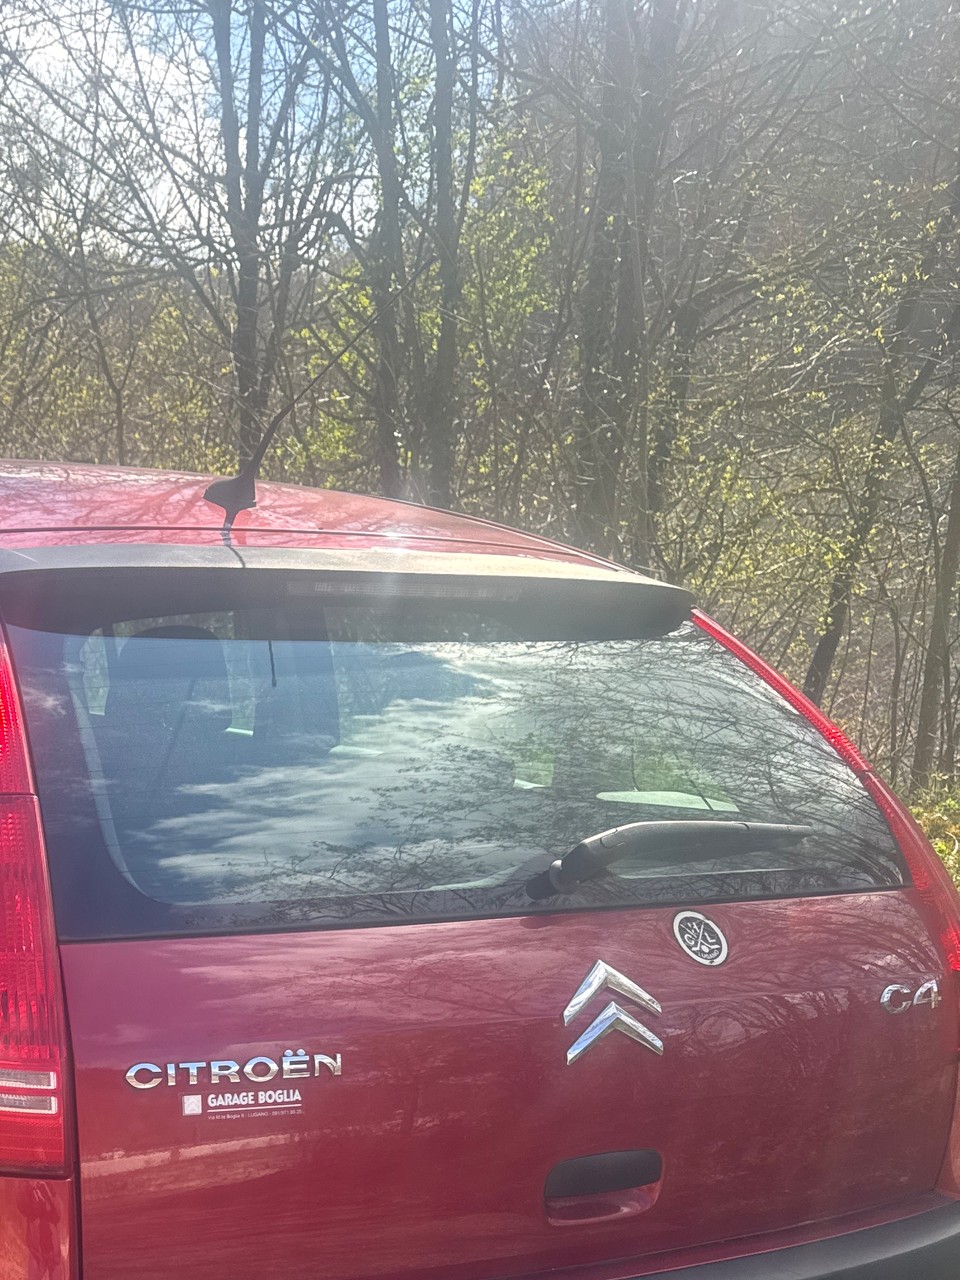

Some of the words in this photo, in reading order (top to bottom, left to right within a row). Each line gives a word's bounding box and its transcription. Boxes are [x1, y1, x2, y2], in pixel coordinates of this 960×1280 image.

[880, 979, 942, 1014] C4
[125, 1048, 342, 1090] CITROËN
[207, 1092, 255, 1108] GARAGE
[257, 1088, 302, 1104] BOGLIA
